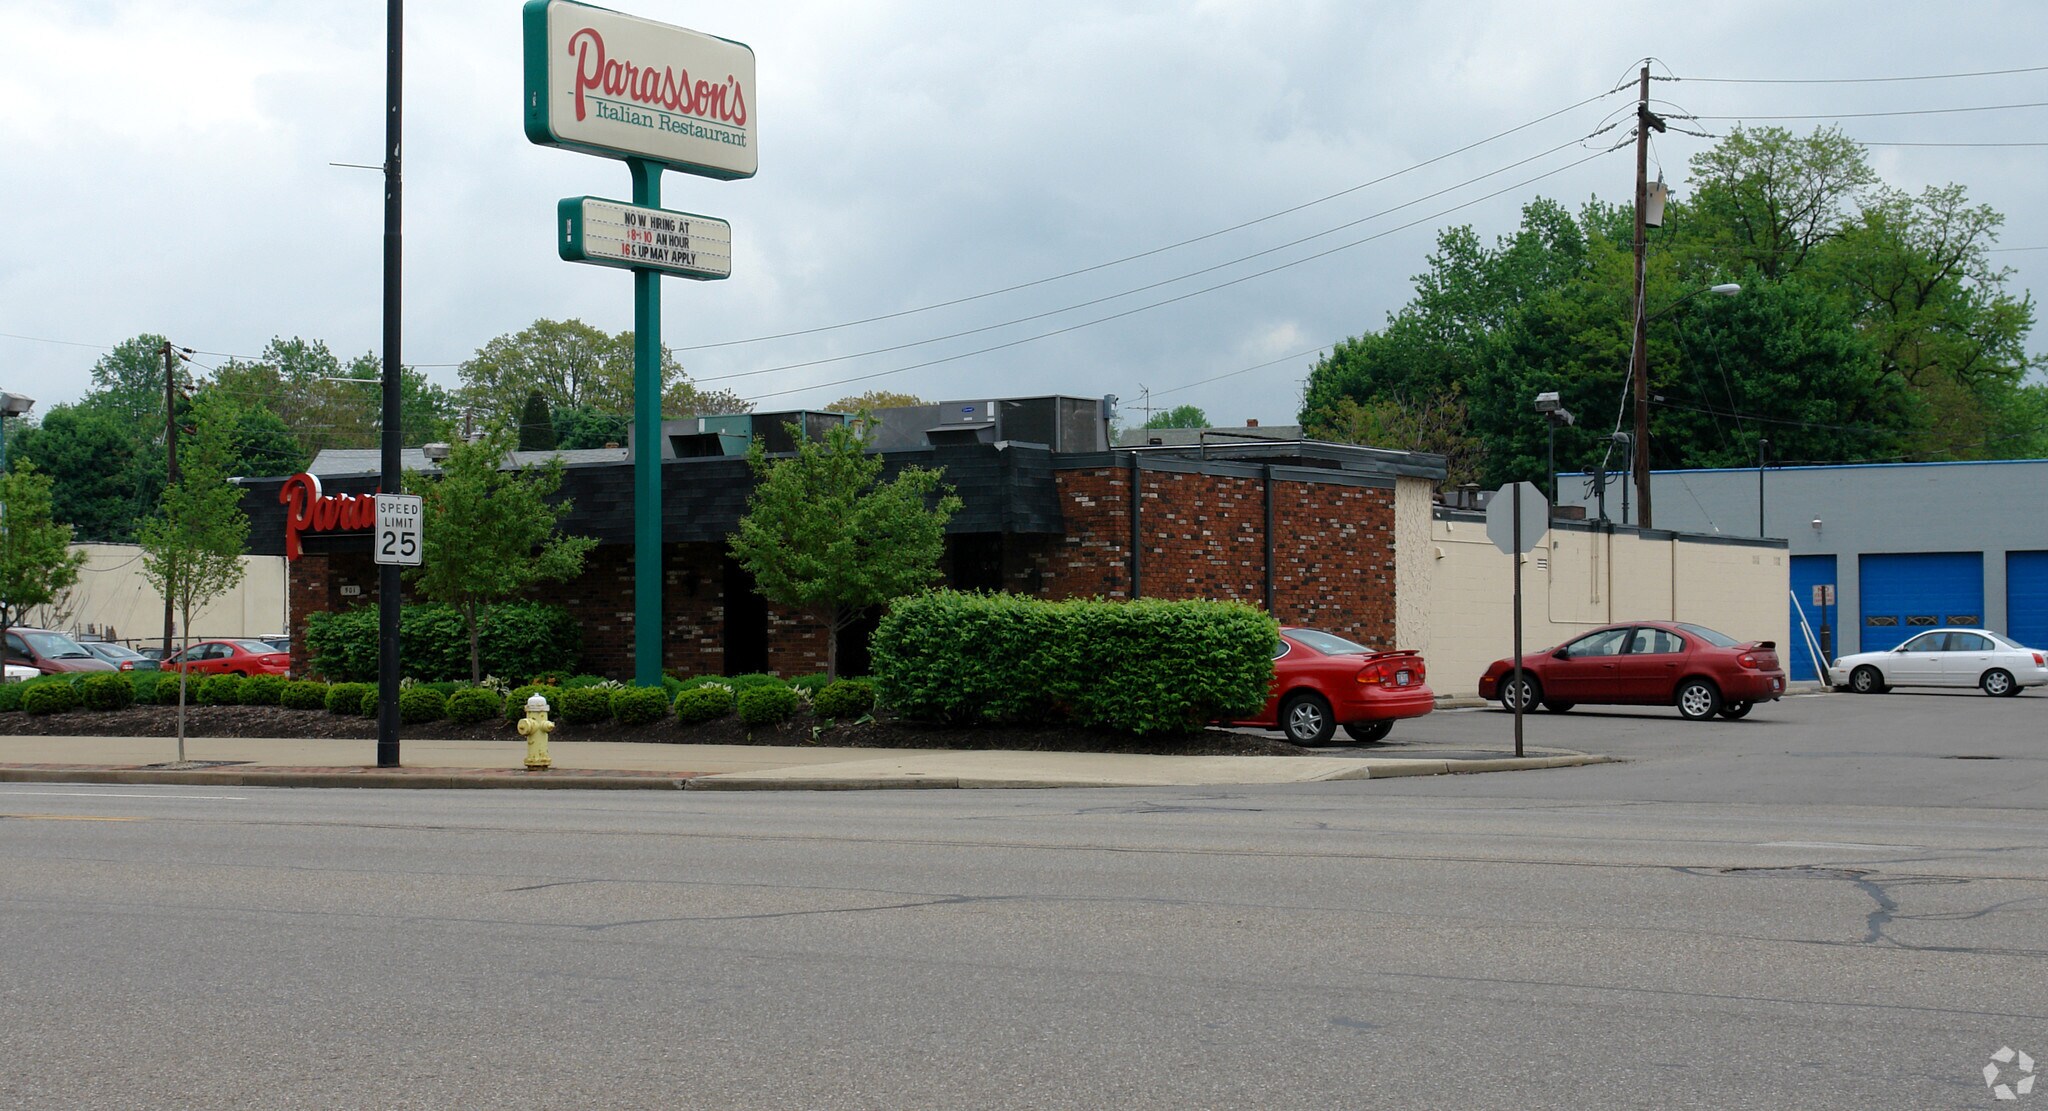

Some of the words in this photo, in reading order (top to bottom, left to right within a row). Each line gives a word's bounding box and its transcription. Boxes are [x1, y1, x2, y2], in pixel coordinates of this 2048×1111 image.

[568, 27, 747, 126] Parasson's
[595, 101, 654, 129] Italian
[658, 113, 747, 148] Restaurant
[678, 221, 690, 234] AT
[655, 232, 668, 246] AN
[668, 234, 690, 249] HOUR
[621, 242, 631, 256] 16
[631, 244, 637, 256] &
[638, 245, 649, 258] UP
[649, 246, 669, 261] MAY
[671, 250, 697, 265] APPLY
[380, 502, 418, 515] SPEED
[384, 517, 414, 529] LIMIT
[381, 530, 416, 557] 25
